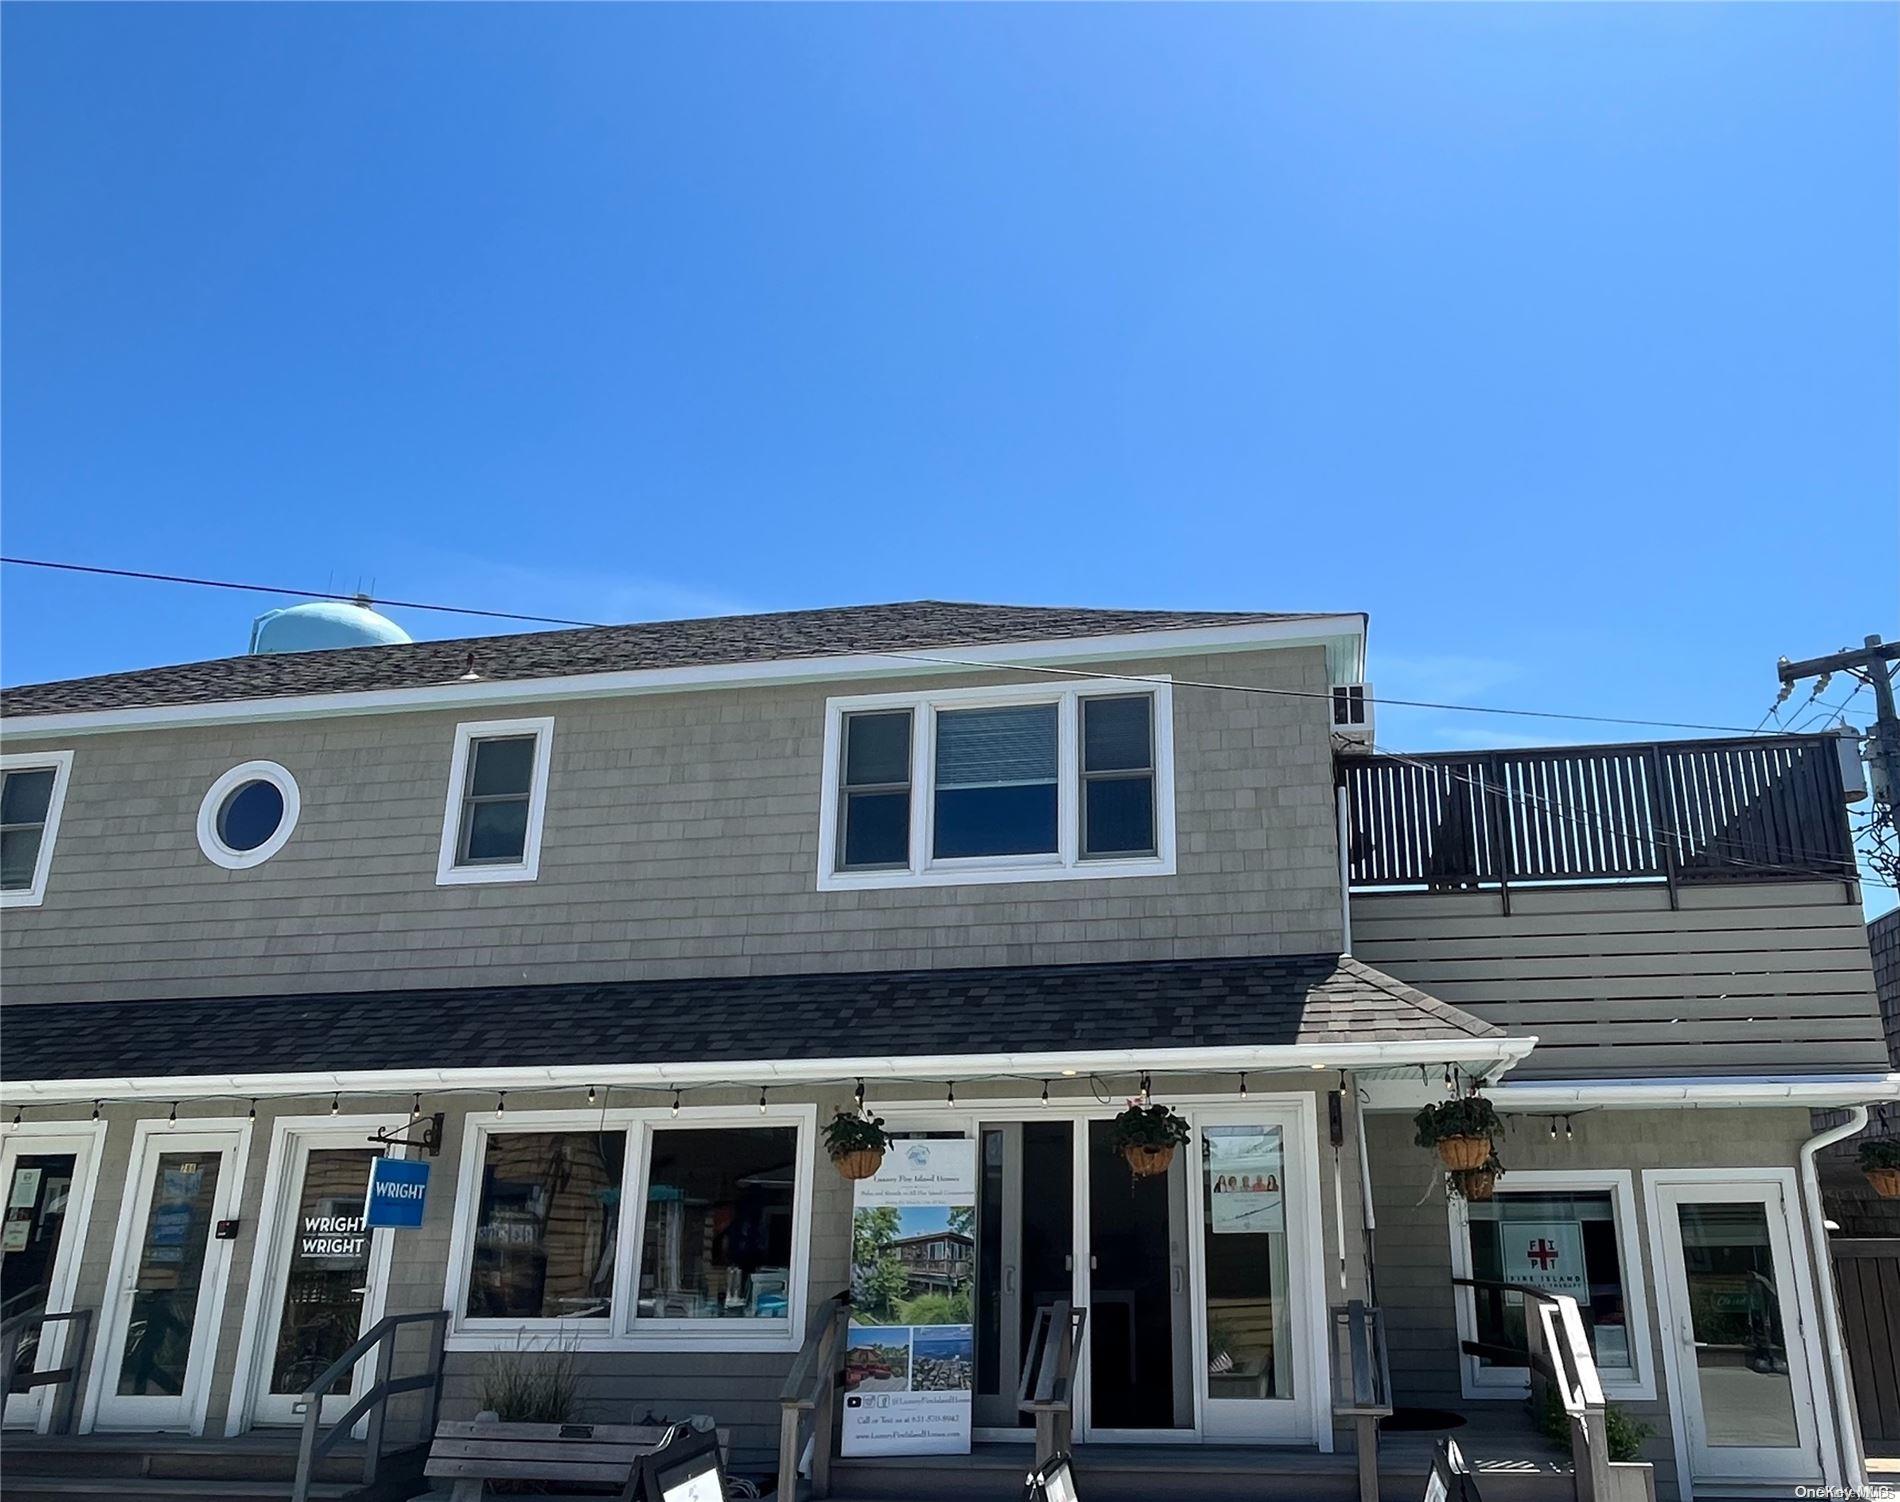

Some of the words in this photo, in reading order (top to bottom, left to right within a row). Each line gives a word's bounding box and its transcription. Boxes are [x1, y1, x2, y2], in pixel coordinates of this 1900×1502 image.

[899, 1174, 912, 1182] Fire
[914, 1174, 936, 1182] Island
[376, 1181, 426, 1200] WRIGHT
[305, 1217, 366, 1232] WRIGHT
[302, 1239, 365, 1253] WRIGHT
[857, 1416, 870, 1424] Call
